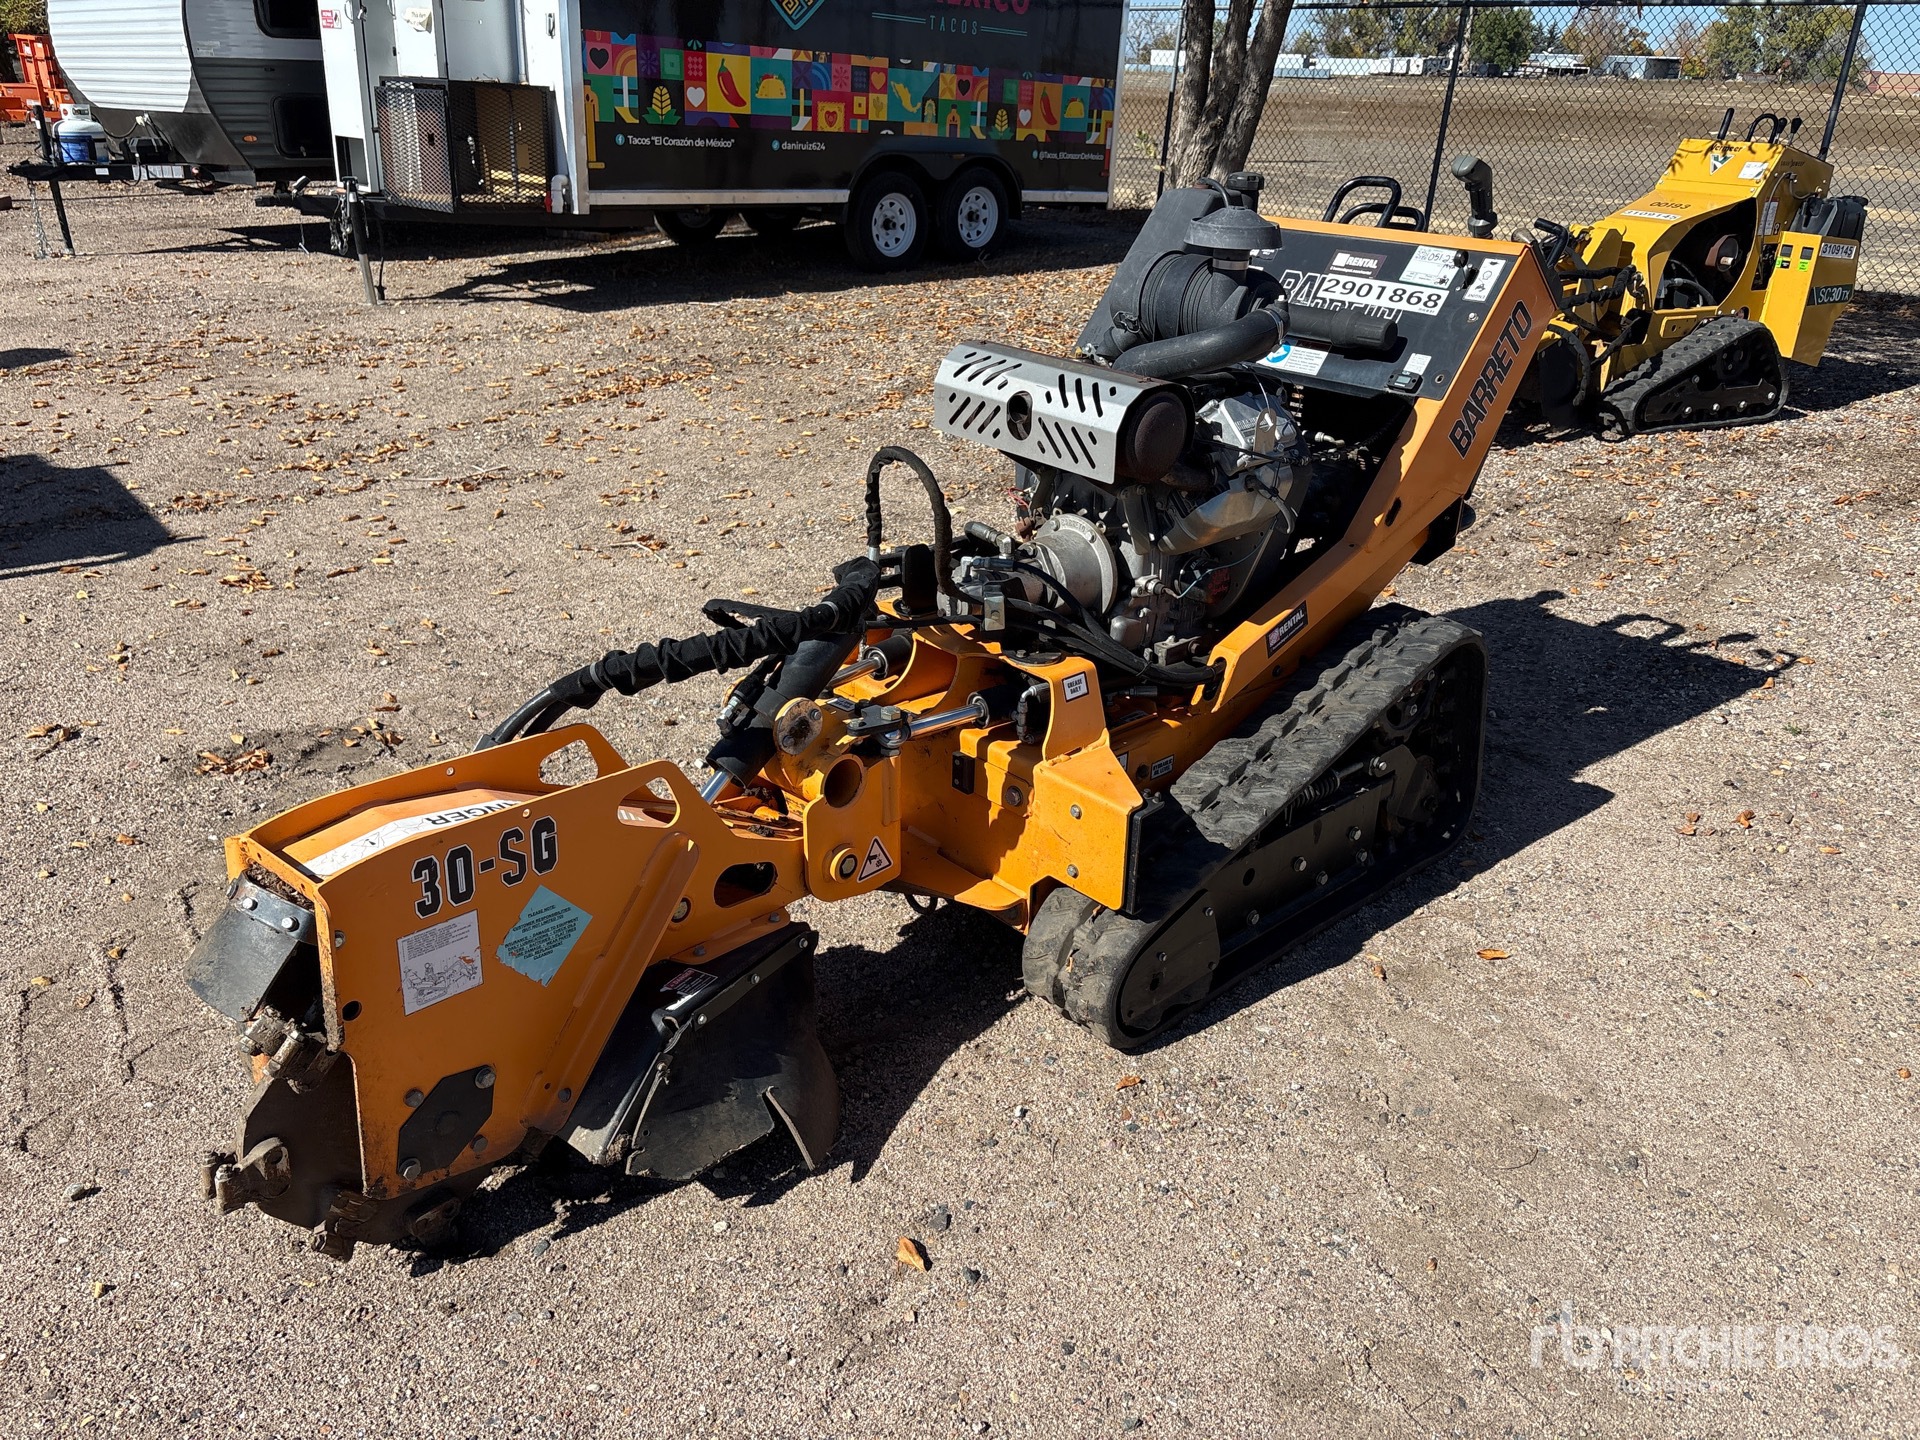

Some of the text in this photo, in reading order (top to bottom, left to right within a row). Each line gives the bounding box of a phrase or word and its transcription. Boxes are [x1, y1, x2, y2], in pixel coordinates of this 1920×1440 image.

[929, 15, 977, 35] TACOS
[627, 135, 651, 145] Tacos
[663, 137, 694, 146] Corazón
[694, 138, 705, 147] de
[782, 141, 826, 151] daniruiz624
[1649, 201, 1691, 209] 00193
[1822, 243, 1853, 256] 3109145
[1345, 256, 1378, 269] RENTAL
[1321, 277, 1441, 309] 2901868
[1448, 300, 1533, 460] BARRETO
[1279, 609, 1304, 636] RENTAL
[1067, 678, 1083, 689] GREASE
[1070, 685, 1082, 695] DAILY
[411, 816, 558, 919] 30-SG
[528, 908, 543, 918] PLEASE
[513, 920, 535, 932] CUSTOMER
